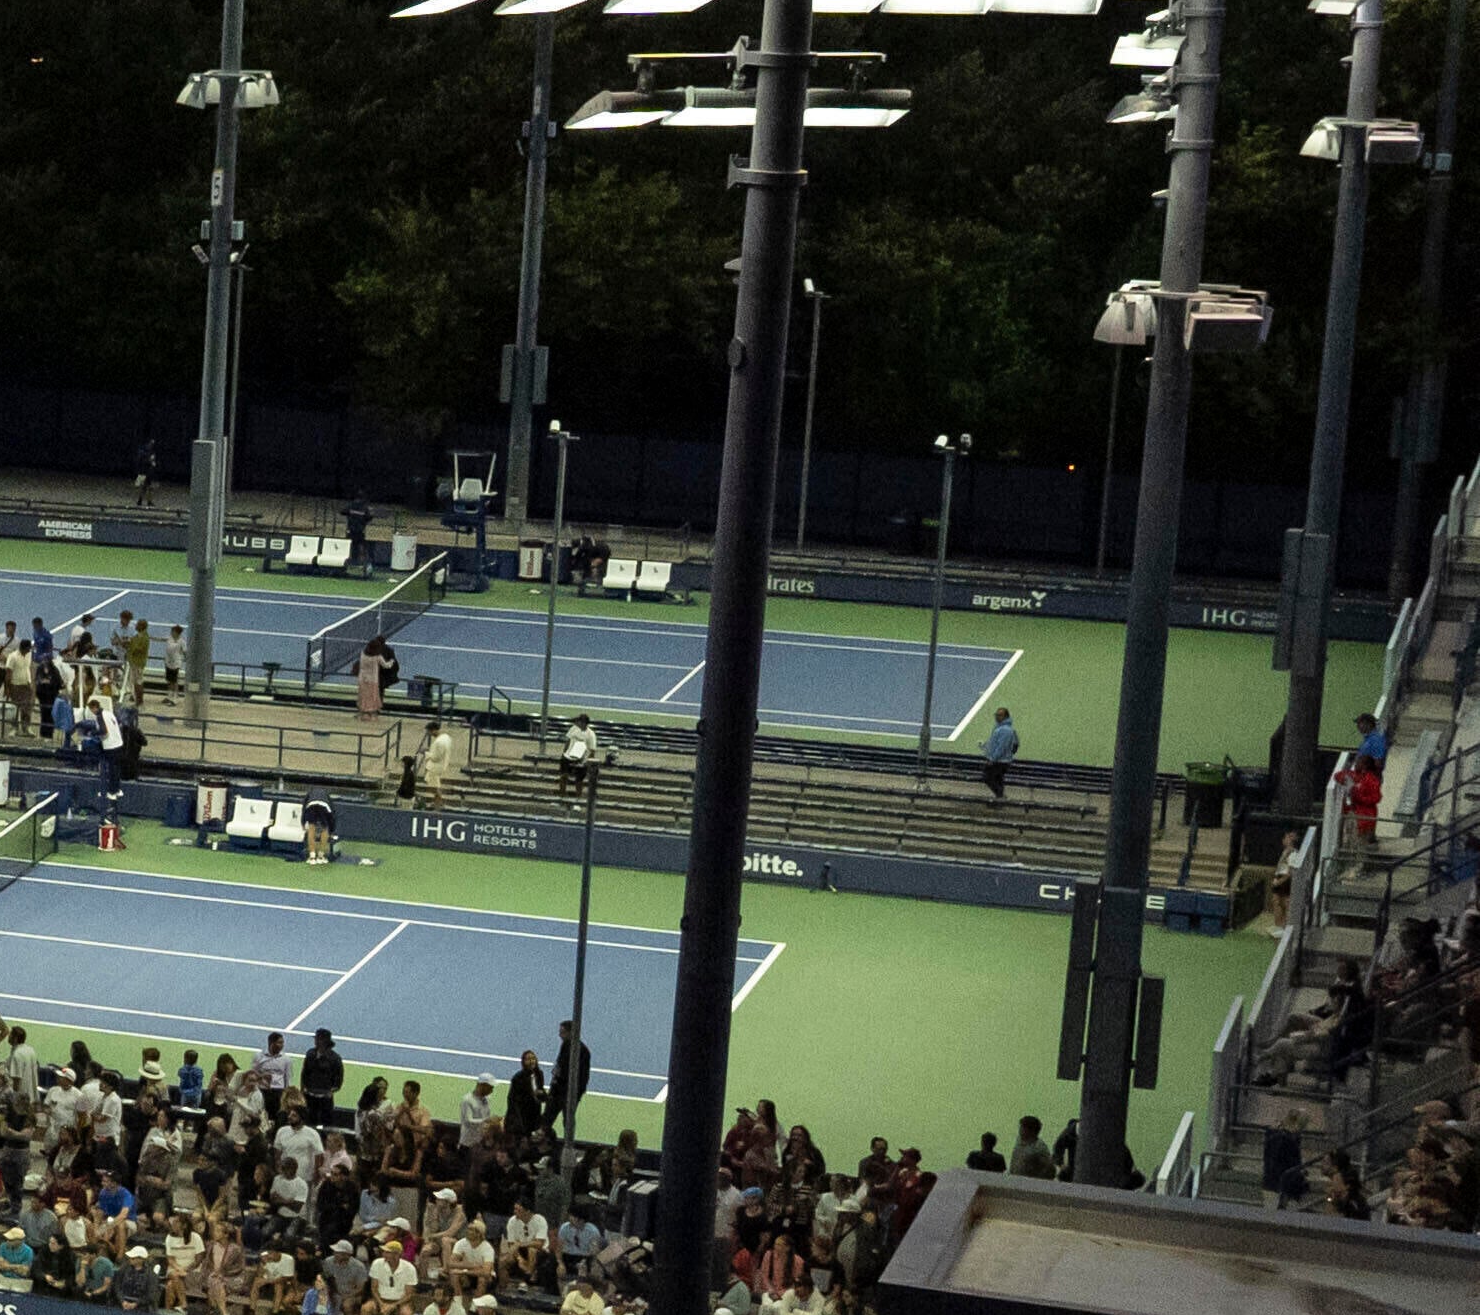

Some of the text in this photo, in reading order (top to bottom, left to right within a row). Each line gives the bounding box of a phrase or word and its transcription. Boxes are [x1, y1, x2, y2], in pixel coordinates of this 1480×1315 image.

[38, 520, 92, 531] AMERICAN
[45, 528, 92, 540] EXPRESS
[767, 575, 815, 593] irates
[972, 592, 1032, 610] argenx
[1202, 607, 1247, 626] IHG
[412, 817, 466, 842] IHG
[473, 822, 538, 838] HOTELS &
[472, 834, 538, 850] RESORTS
